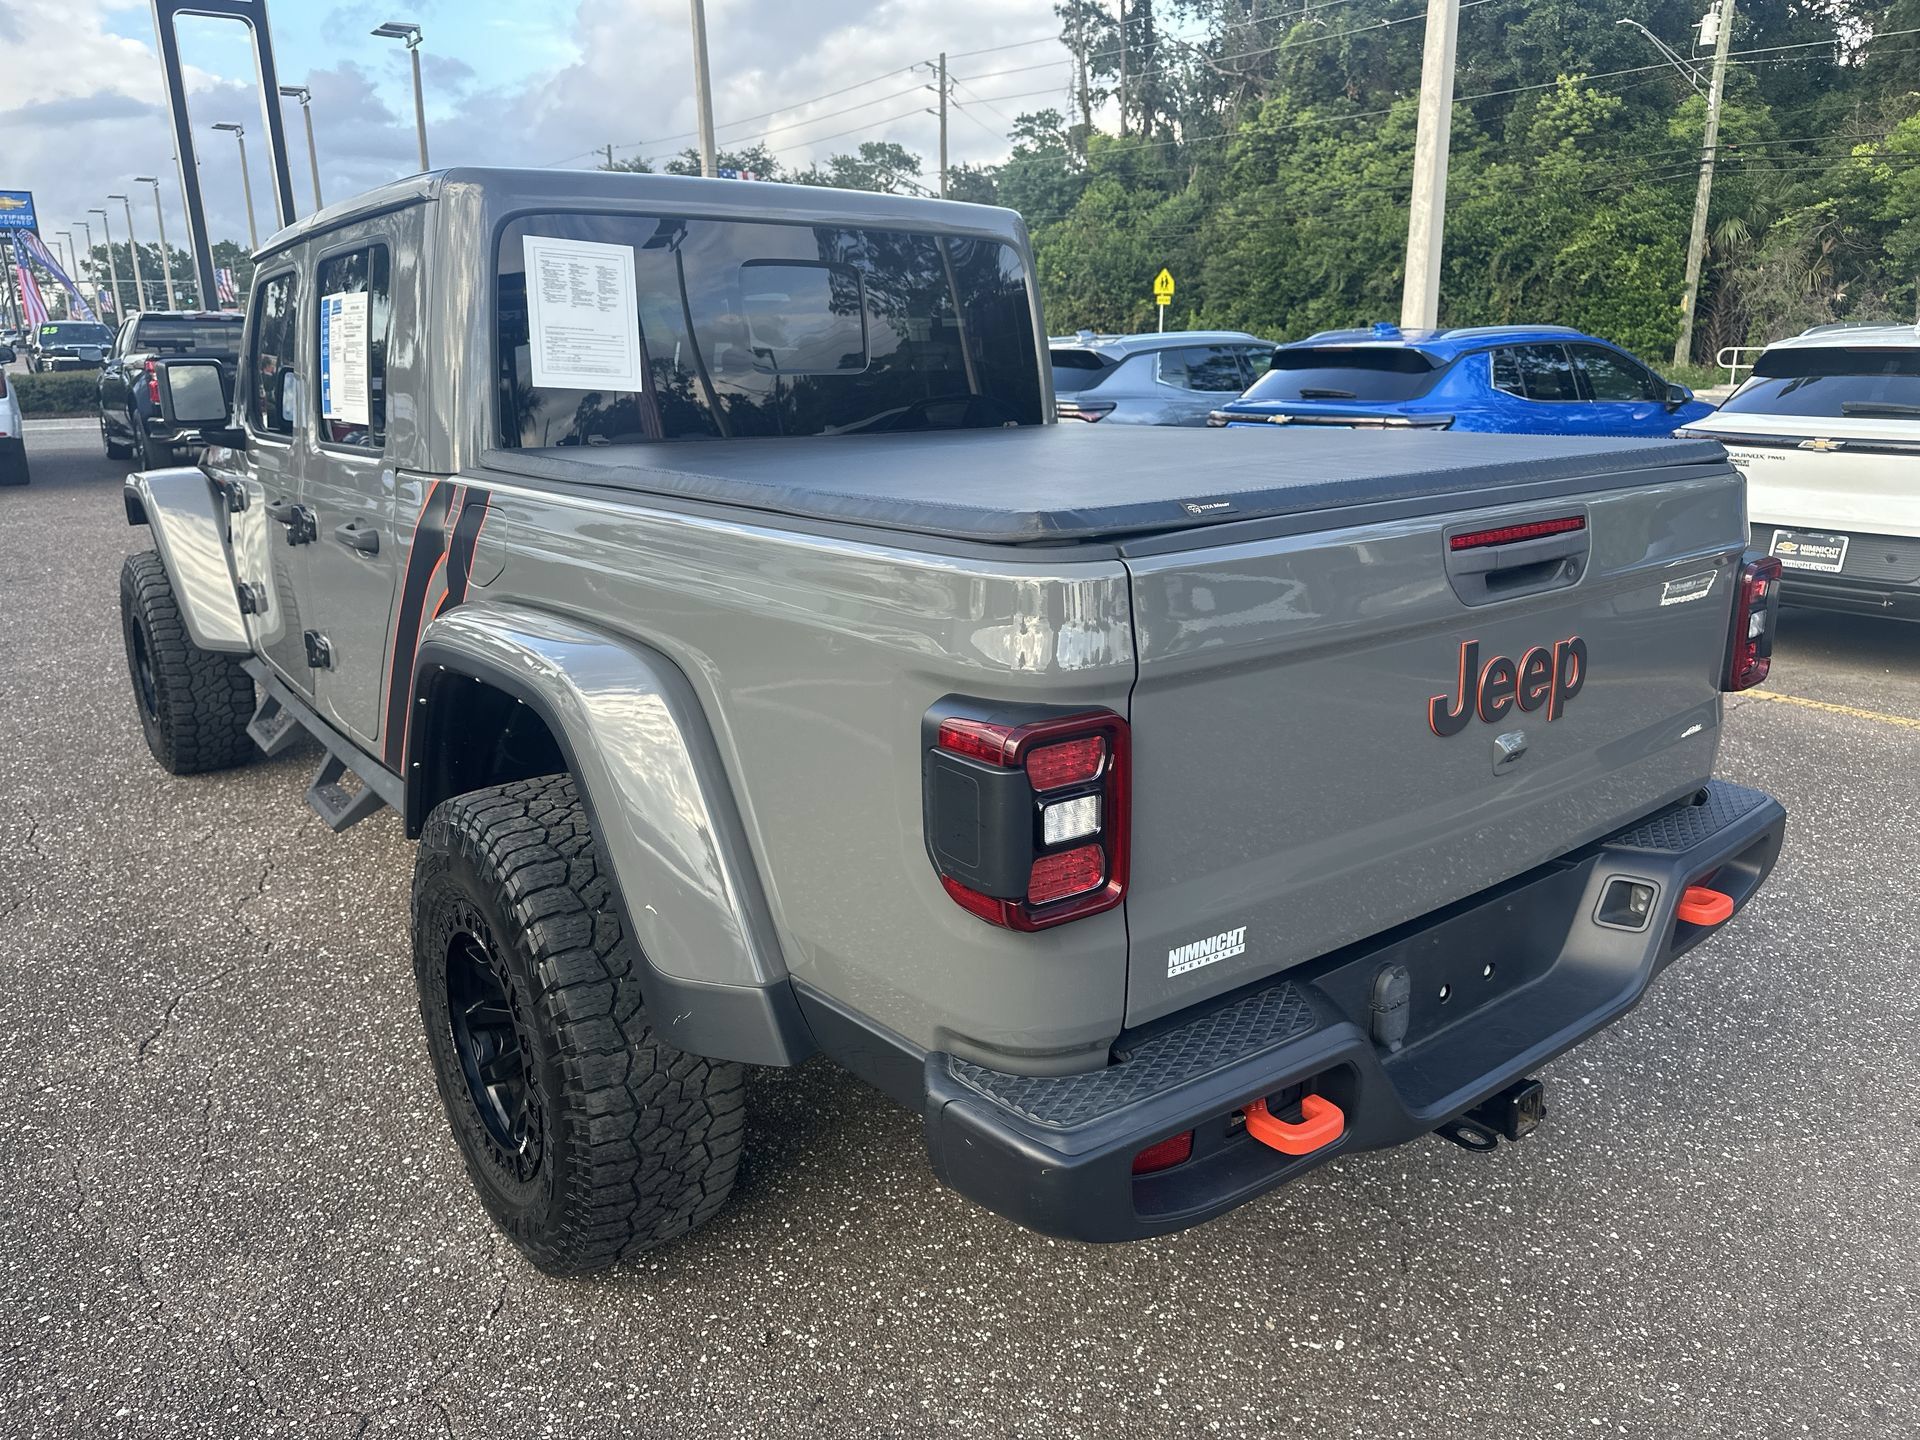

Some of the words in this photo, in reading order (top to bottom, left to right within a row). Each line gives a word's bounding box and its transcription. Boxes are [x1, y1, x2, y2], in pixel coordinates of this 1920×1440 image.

[41, 326, 58, 335] 25
[1429, 635, 1588, 737] Jeep
[1167, 925, 1247, 968] NIMNICHT
[1171, 946, 1242, 975] CHEVROLET
